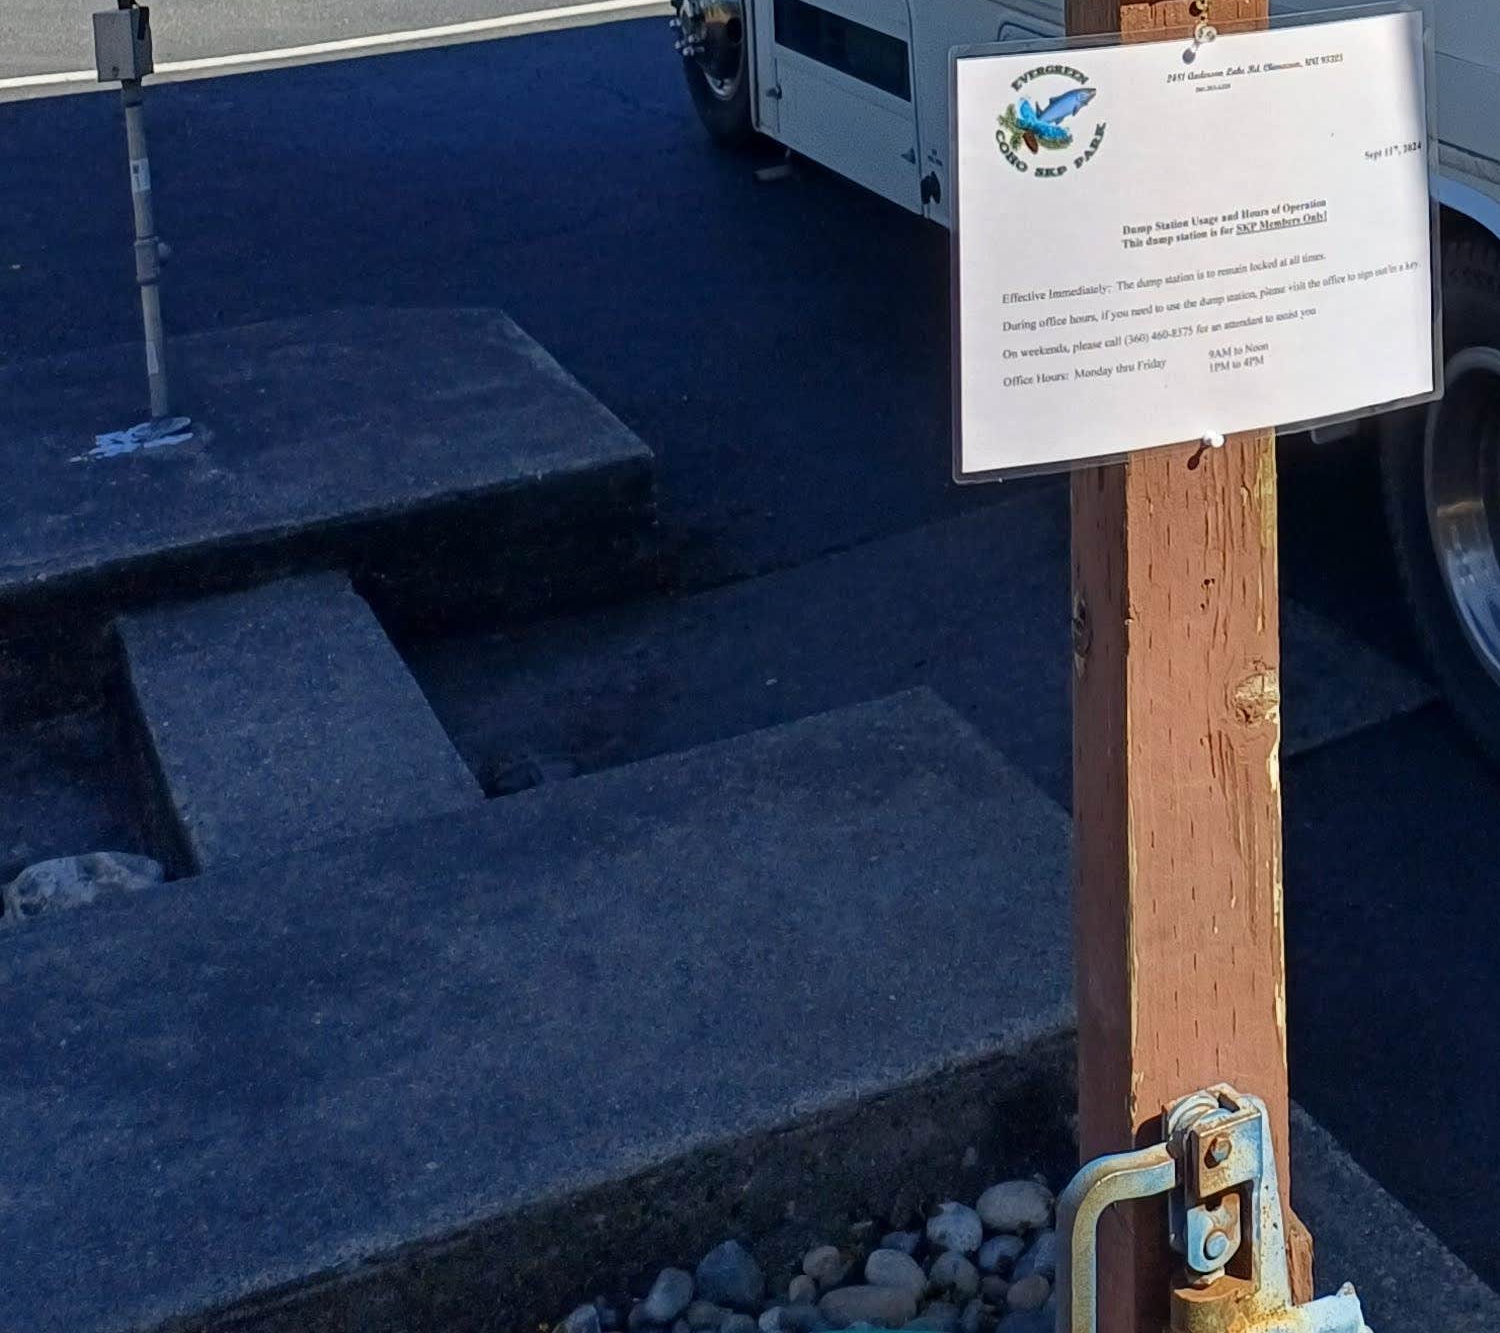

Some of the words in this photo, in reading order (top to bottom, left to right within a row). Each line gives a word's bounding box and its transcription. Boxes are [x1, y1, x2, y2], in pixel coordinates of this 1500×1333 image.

[1011, 64, 1090, 92] EVERGREEN
[995, 129, 1028, 173] COHO
[1034, 165, 1068, 178] SKP
[1073, 122, 1107, 169] PARK
[1122, 238, 1144, 249] This
[1146, 233, 1174, 247] dump
[1176, 228, 1208, 242] station
[1210, 227, 1218, 238] is
[1220, 225, 1234, 237] for
[1236, 223, 1258, 235] SKP
[1259, 216, 1301, 231] Members
[1123, 224, 1153, 236] Dump
[1155, 220, 1189, 232] Station
[1192, 215, 1219, 228] Usage
[1222, 211, 1239, 222] and
[1242, 209, 1269, 220] Hours
[1272, 205, 1281, 215] of
[1282, 198, 1327, 215] Operation
[1002, 291, 1046, 304] Effective
[1116, 280, 1135, 291] The
[1136, 277, 1164, 290] dump
[1165, 272, 1195, 285] station
[1196, 270, 1205, 280] is
[1206, 270, 1216, 279] to
[1217, 264, 1248, 277] remain
[1250, 259, 1278, 273] locked
[1279, 257, 1288, 268] at
[1289, 254, 1301, 265] all
[1002, 320, 1037, 334] During
[1038, 316, 1067, 329] office
[1069, 312, 1099, 326] hours,
[1101, 310, 1109, 321] if
[1110, 309, 1129, 323] you
[1131, 303, 1154, 316] need
[1155, 303, 1165, 313] to
[1166, 301, 1181, 311] use
[1183, 298, 1198, 309] the
[1308, 277, 1321, 290] the
[1323, 273, 1346, 287] office
[1347, 272, 1356, 282] to
[1002, 348, 1018, 360] On
[1021, 341, 1071, 358] weekends,
[1072, 340, 1103, 354] please
[1104, 336, 1122, 348] call
[1124, 332, 1149, 348] (360)
[1265, 312, 1274, 323] to
[1003, 374, 1034, 388] Office
[1074, 365, 1114, 381] Monday
[1116, 361, 1135, 374] thru
[1137, 357, 1167, 372] Friday
[1208, 345, 1232, 359] 9AM
[1233, 344, 1243, 355] to
[1244, 341, 1269, 354] Noon
[1232, 358, 1242, 369] to
[1243, 354, 1265, 368] 4PM
